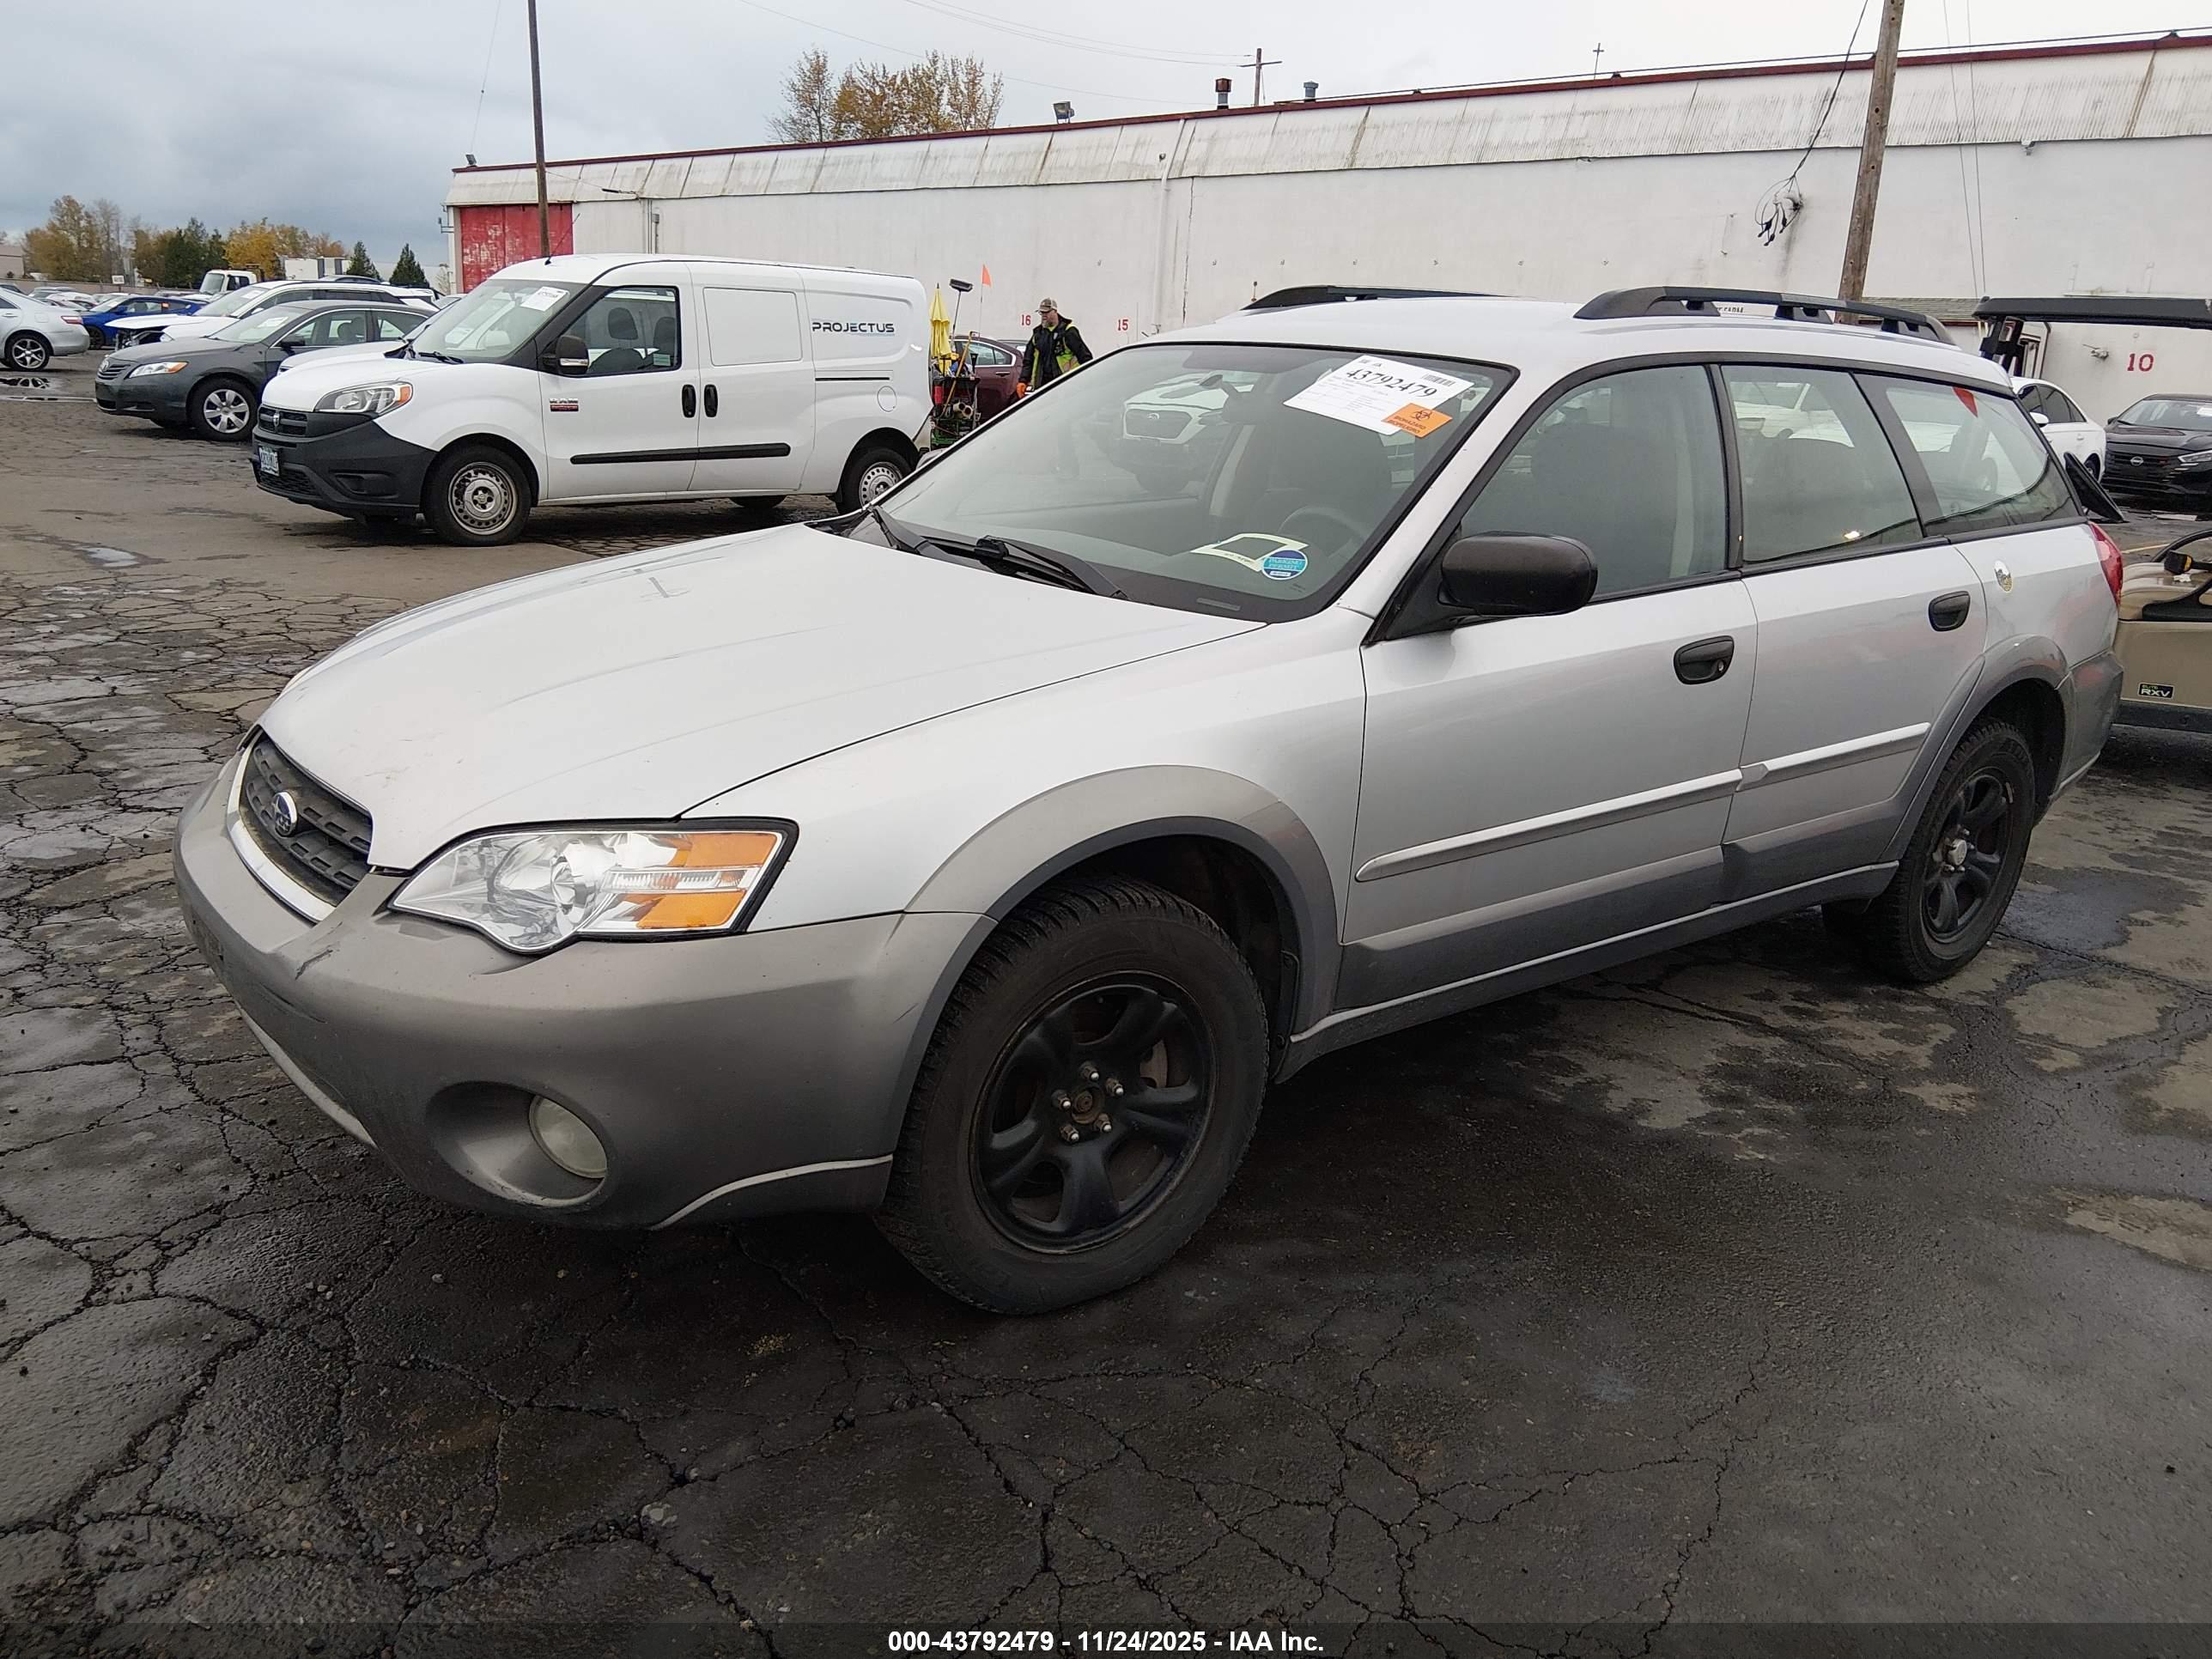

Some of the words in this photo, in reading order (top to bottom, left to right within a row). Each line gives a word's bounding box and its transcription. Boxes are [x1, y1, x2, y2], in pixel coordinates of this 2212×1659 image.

[1020, 314, 1031, 325] 16
[1117, 319, 1128, 331] 15
[811, 322, 895, 333] PROJECTUS
[2127, 353, 2154, 372] 10
[1346, 368, 1437, 398] 43792479
[1394, 416, 1426, 430] BIOHAZARD
